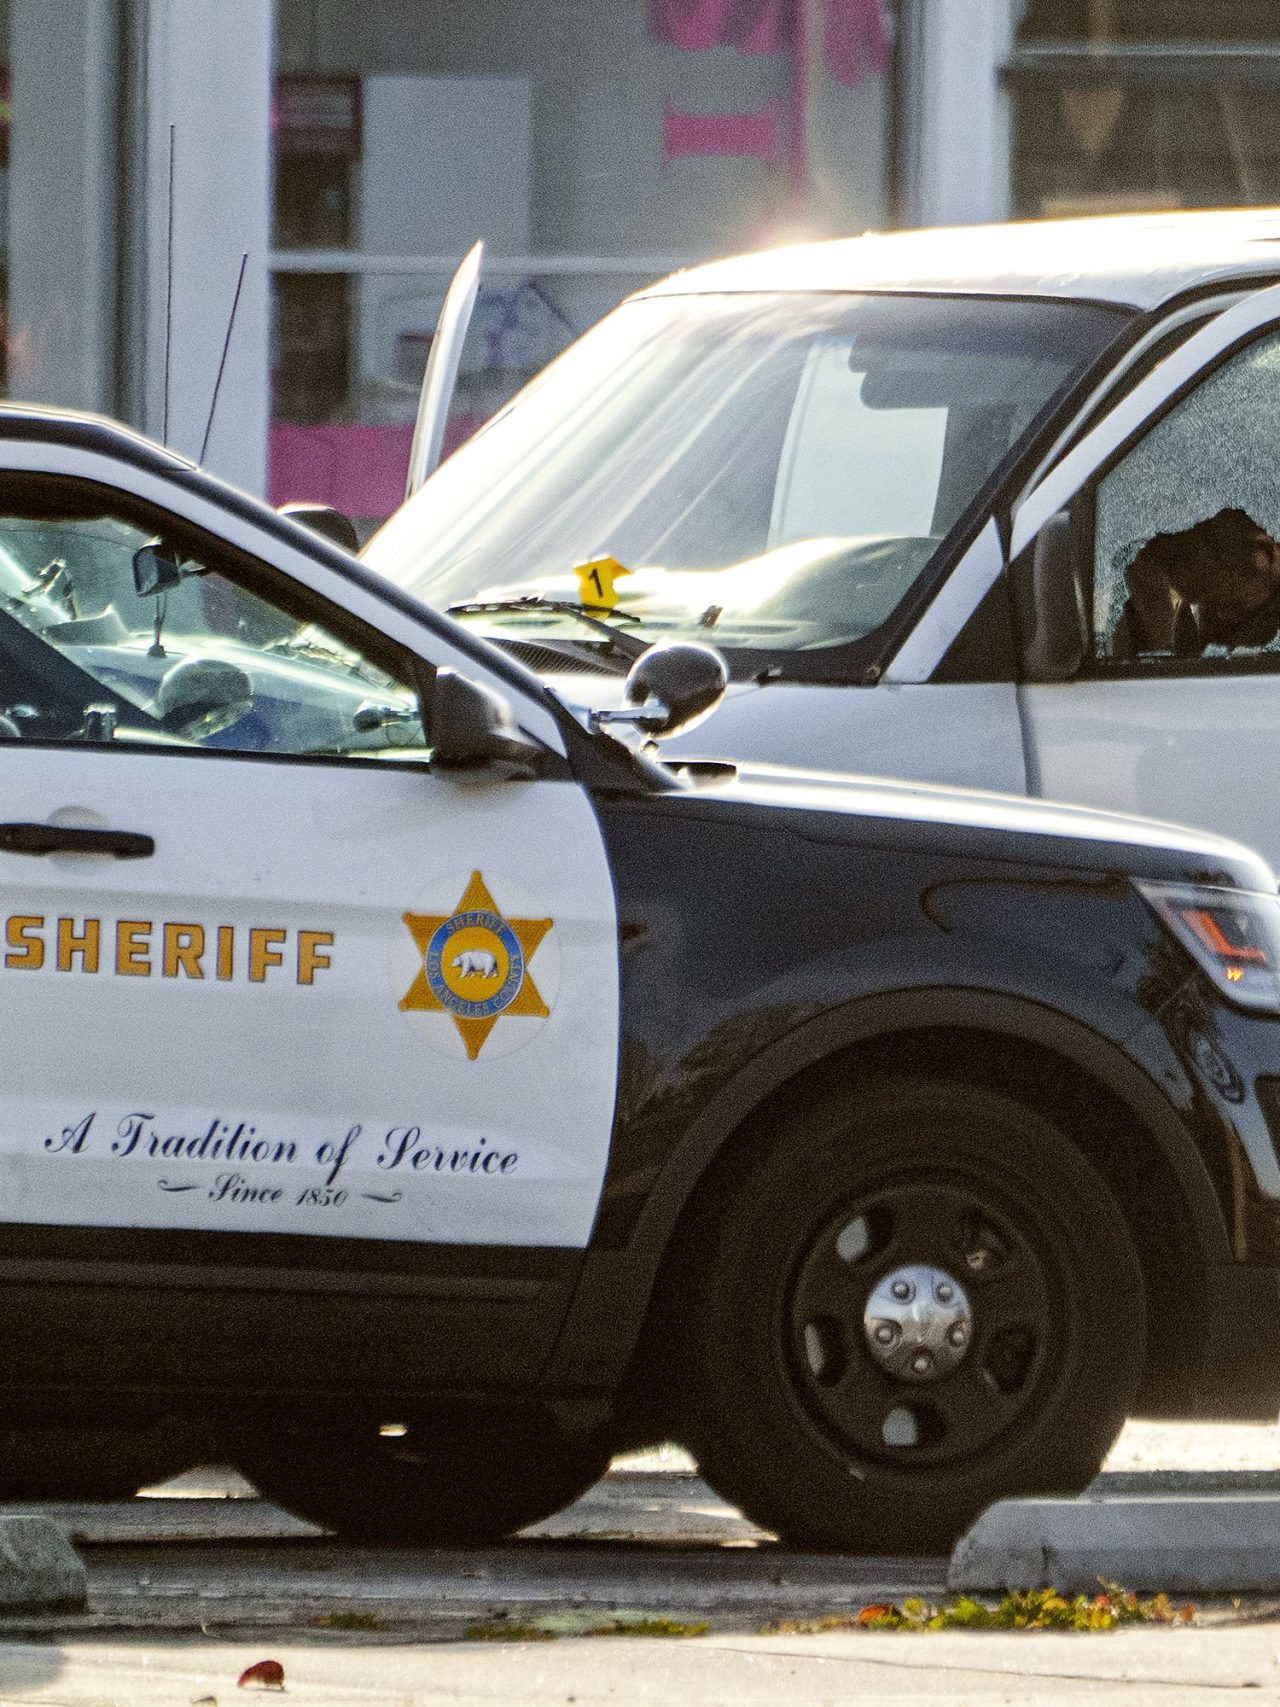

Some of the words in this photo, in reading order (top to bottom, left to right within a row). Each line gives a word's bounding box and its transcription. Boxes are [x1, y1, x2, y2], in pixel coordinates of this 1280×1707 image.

[588, 567, 604, 599] 1
[446, 913, 505, 935] SHERIFF
[4, 914, 335, 986] SHERIFF
[44, 1111, 97, 1154] A
[111, 1113, 299, 1164] Tradition
[315, 1124, 362, 1185] of
[376, 1126, 520, 1176] Service
[206, 1172, 285, 1204] Since
[295, 1186, 349, 1208] 1850
